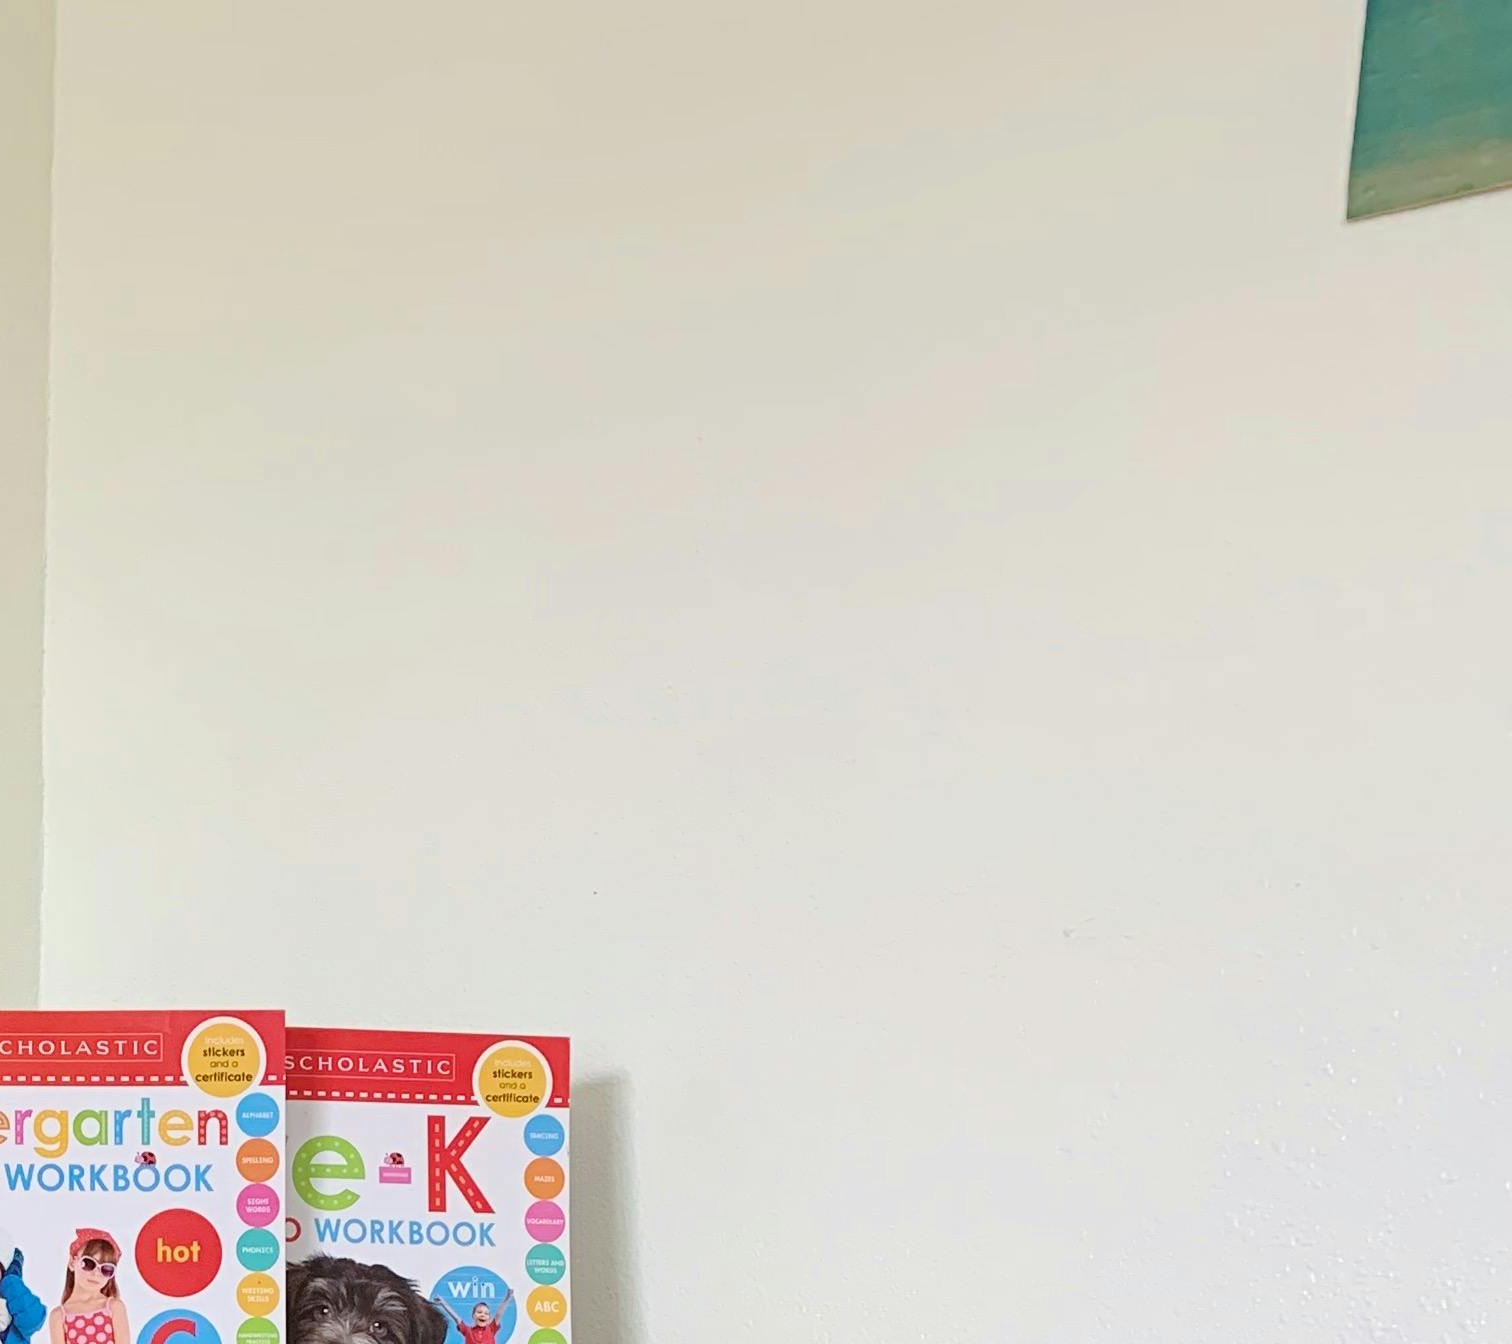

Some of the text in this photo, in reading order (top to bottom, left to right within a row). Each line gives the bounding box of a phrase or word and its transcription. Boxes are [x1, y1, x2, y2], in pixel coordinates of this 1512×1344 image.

[203, 1046, 245, 1057] stickers
[210, 1060, 229, 1068] and
[285, 1054, 452, 1076] SCHOLASTIC
[195, 1071, 253, 1082] certificate
[492, 1069, 533, 1079] stickers
[499, 1081, 517, 1089] and
[485, 1092, 540, 1103] certificate
[242, 1156, 274, 1164] SPELLING
[4, 1163, 214, 1193] WORKBOOK
[314, 1217, 497, 1248] WORKBOOK
[156, 1237, 201, 1263] hot
[242, 1246, 274, 1254] PHONICS
[447, 1276, 496, 1299] win
[534, 1301, 560, 1313] ABC
